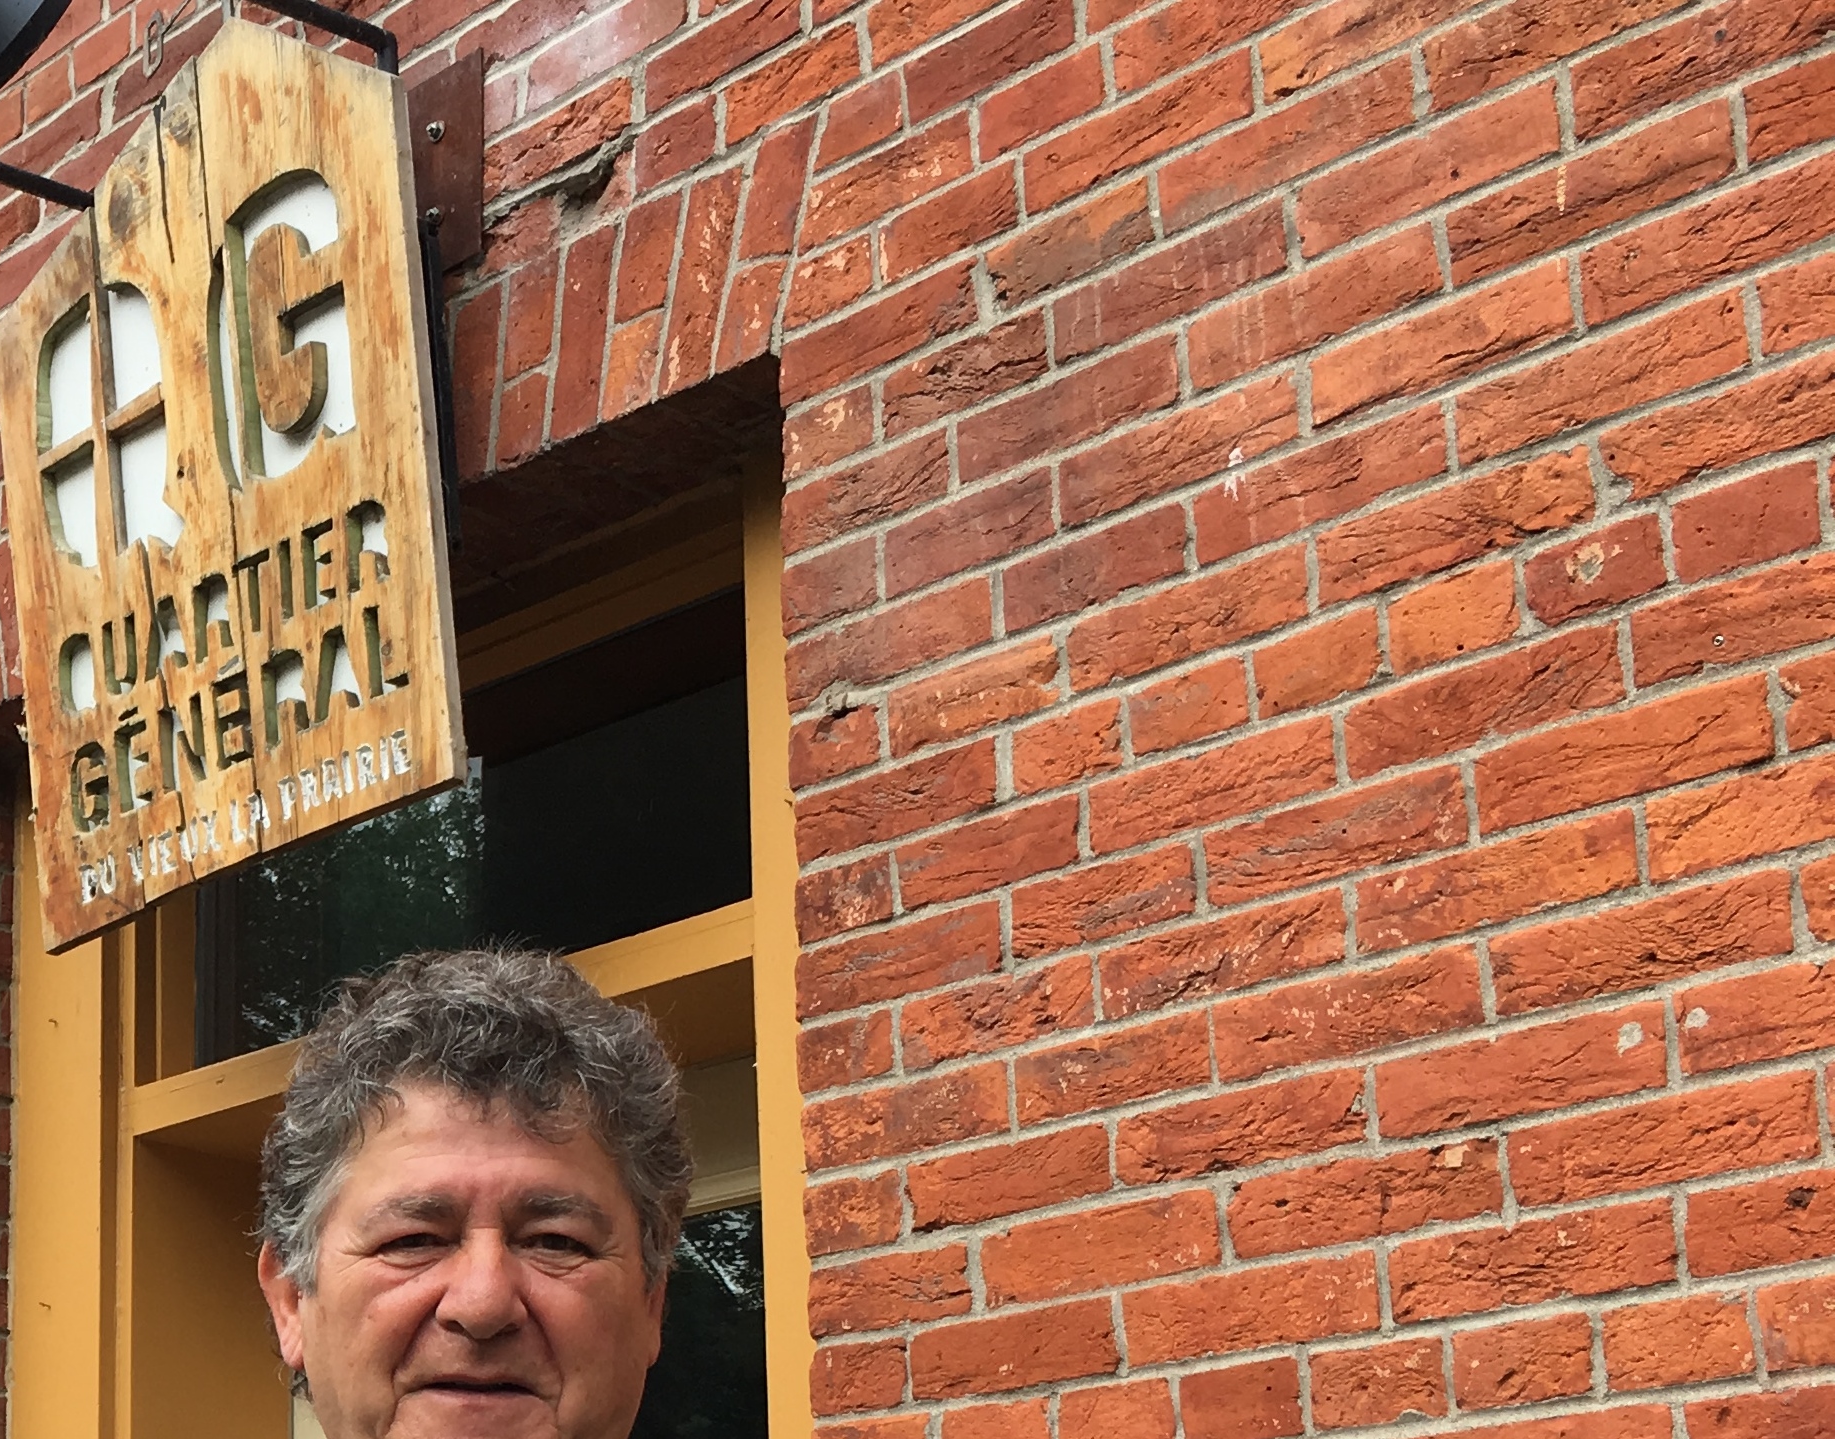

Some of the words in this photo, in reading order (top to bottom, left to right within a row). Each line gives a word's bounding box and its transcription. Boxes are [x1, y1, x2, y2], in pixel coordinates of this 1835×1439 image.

[58, 499, 390, 713] QUARTIER
[70, 605, 409, 833] GÉNÉRAL
[80, 849, 116, 905] DU
[127, 811, 221, 884] VIEUX
[229, 789, 271, 844] LA
[277, 730, 413, 821] PRAIRIE
